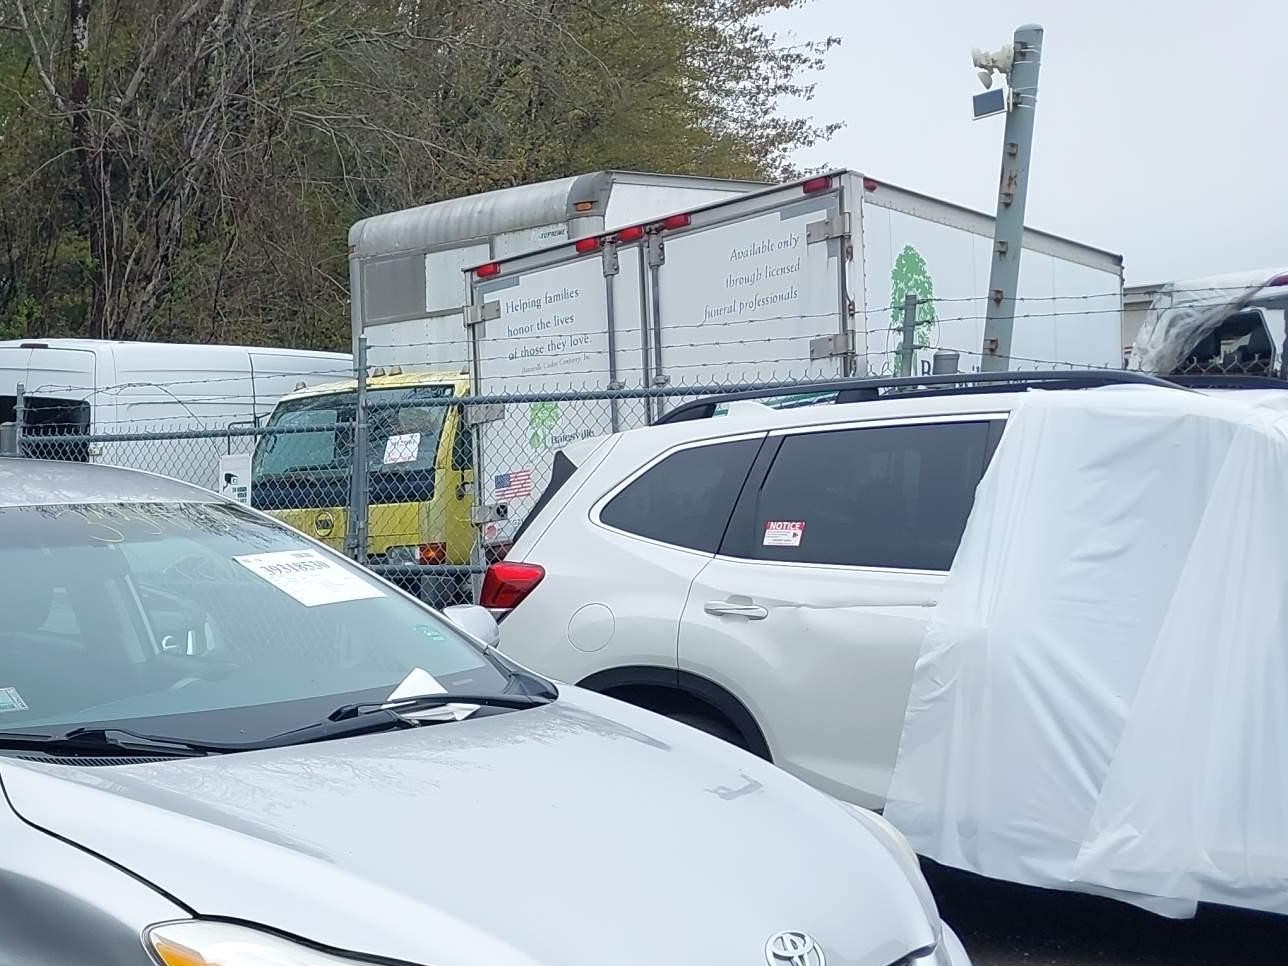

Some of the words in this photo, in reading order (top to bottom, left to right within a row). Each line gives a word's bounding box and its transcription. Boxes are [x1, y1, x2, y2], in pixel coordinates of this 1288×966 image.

[730, 239, 775, 262] Available
[777, 232, 800, 249] only
[726, 267, 763, 288] through
[765, 256, 801, 279] licensed
[506, 298, 542, 314] Helping
[544, 287, 580, 304] families
[704, 299, 737, 321] funeral
[739, 285, 799, 315] professionals
[507, 325, 534, 337] honor
[536, 318, 551, 331] the
[553, 314, 575, 327] lives
[508, 347, 518, 360] of
[520, 345, 545, 358] those
[547, 339, 567, 352] they
[569, 334, 592, 348] love.
[260, 560, 331, 576] 39318530
